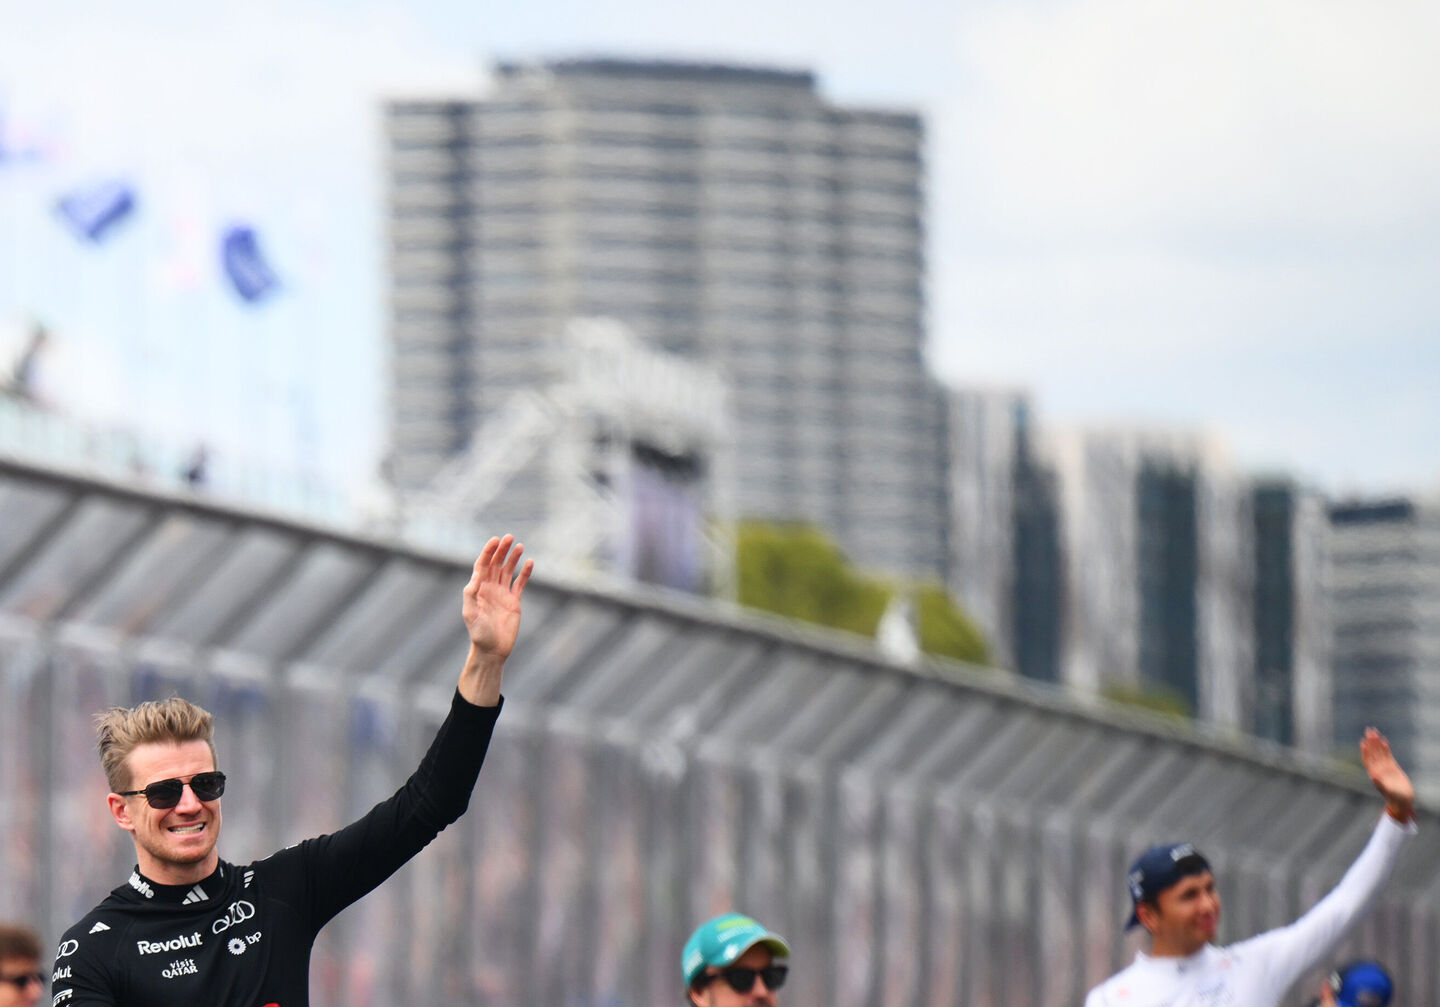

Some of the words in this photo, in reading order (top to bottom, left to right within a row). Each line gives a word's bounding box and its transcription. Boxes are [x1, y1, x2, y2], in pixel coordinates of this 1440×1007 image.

[137, 931, 203, 956] Revolut
[245, 931, 262, 945] bp
[169, 958, 195, 968] visit
[52, 965, 72, 982] olut
[161, 965, 198, 979] QATAR
